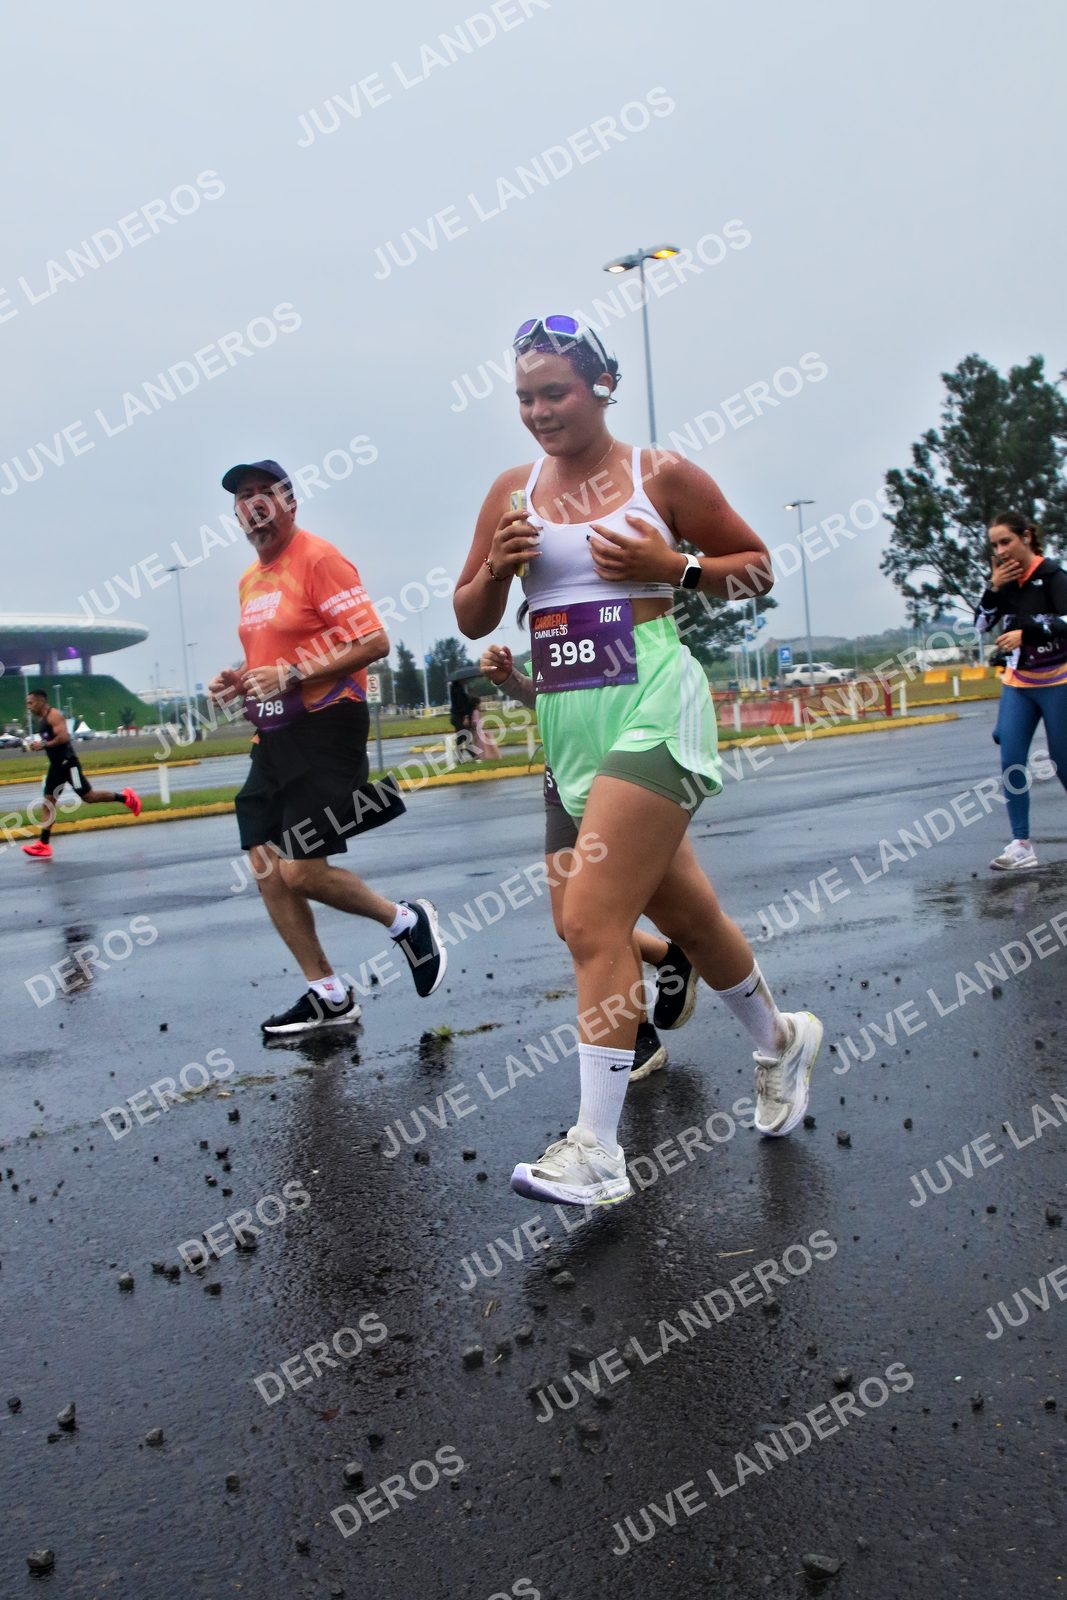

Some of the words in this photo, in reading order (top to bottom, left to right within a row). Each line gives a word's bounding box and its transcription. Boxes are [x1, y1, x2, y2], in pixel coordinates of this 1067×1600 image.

[535, 612, 568, 630] CARRERA
[599, 606, 622, 624] 15K
[549, 639, 596, 667] 398
[256, 700, 284, 717] 798
